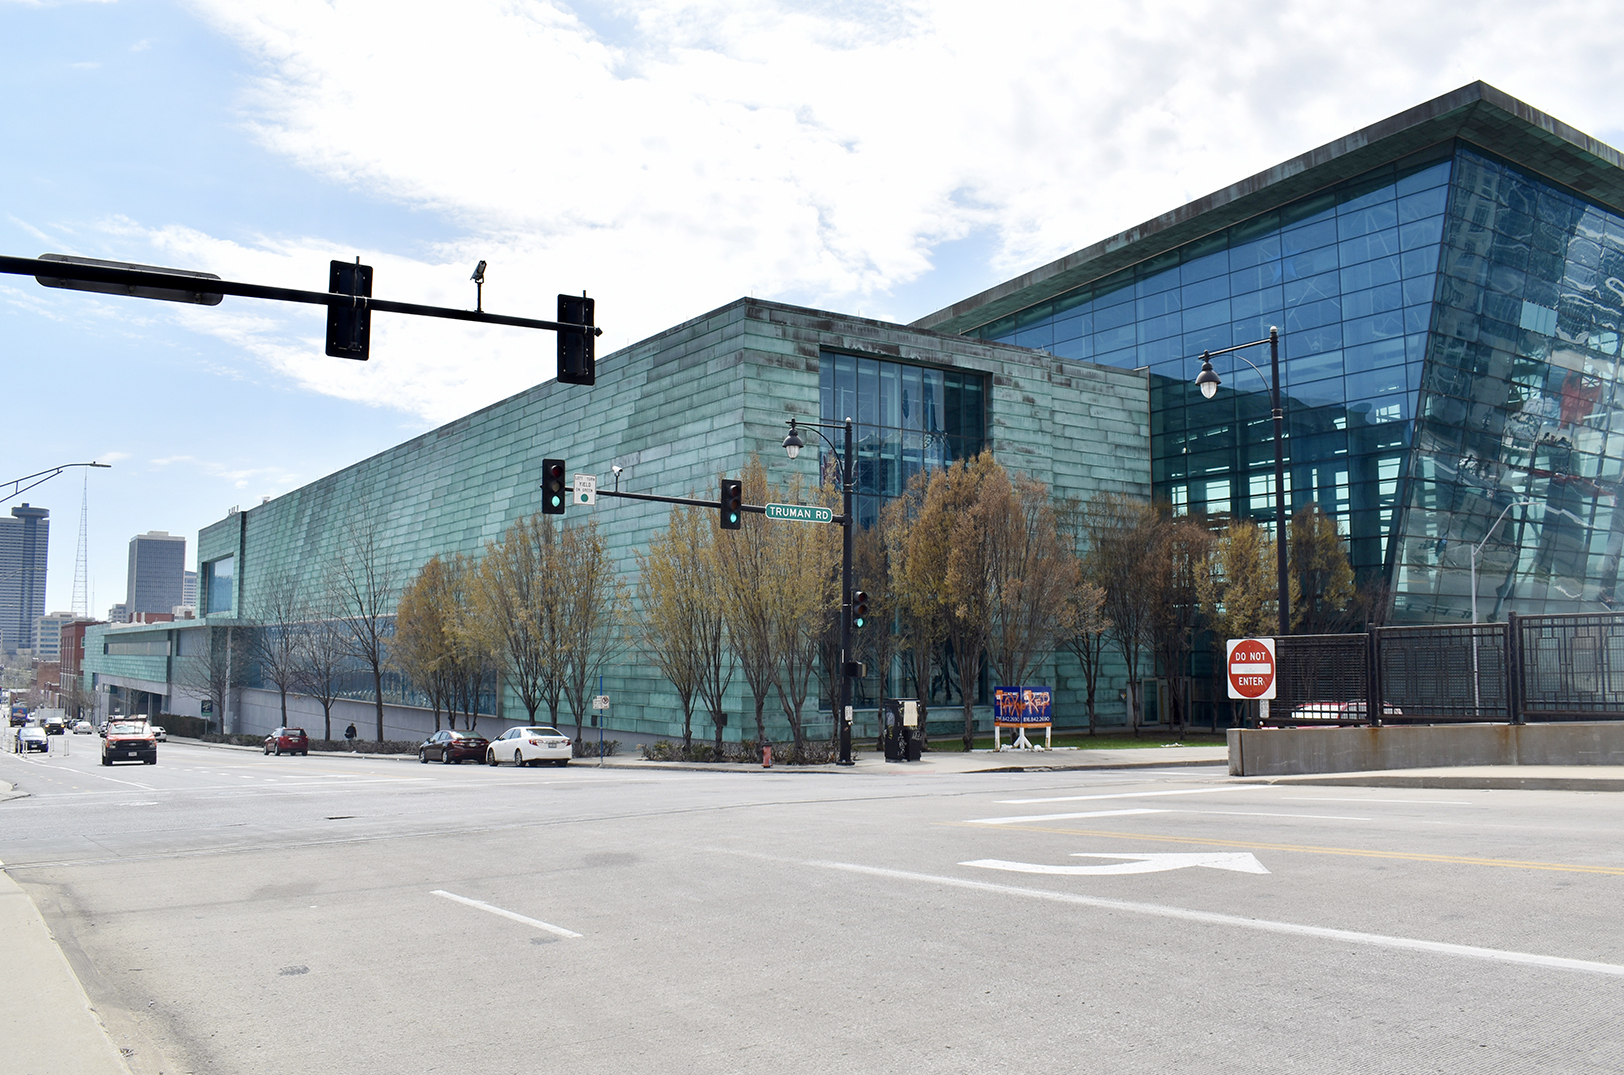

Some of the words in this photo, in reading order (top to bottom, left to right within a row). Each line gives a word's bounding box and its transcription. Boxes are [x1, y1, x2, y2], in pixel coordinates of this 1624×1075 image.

[769, 506, 811, 519] TRUMAN
[815, 510, 829, 520] RD
[1235, 651, 1246, 661] DO
[1249, 651, 1266, 661] NOT
[1238, 676, 1264, 686] ENTER
